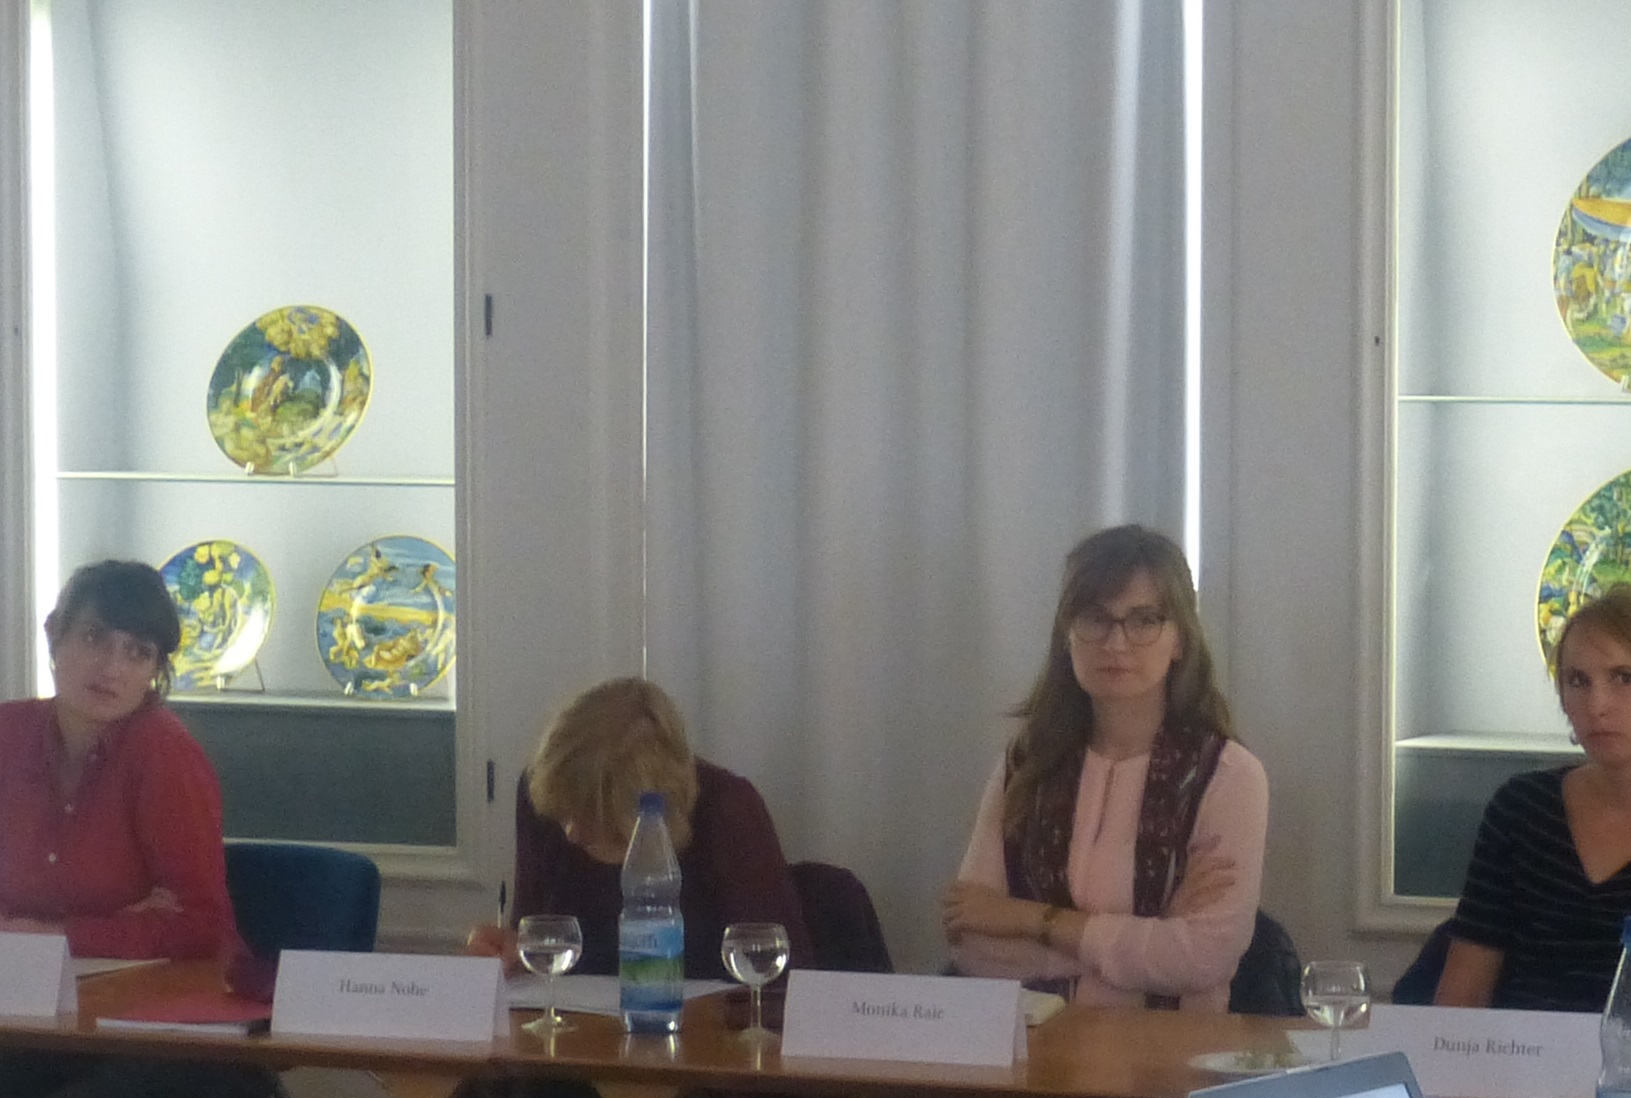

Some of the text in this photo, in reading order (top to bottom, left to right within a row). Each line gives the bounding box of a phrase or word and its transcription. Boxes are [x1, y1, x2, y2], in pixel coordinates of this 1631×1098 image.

[851, 1001, 908, 1018] Monika
[1433, 1036, 1544, 1057] Dunja Richter
